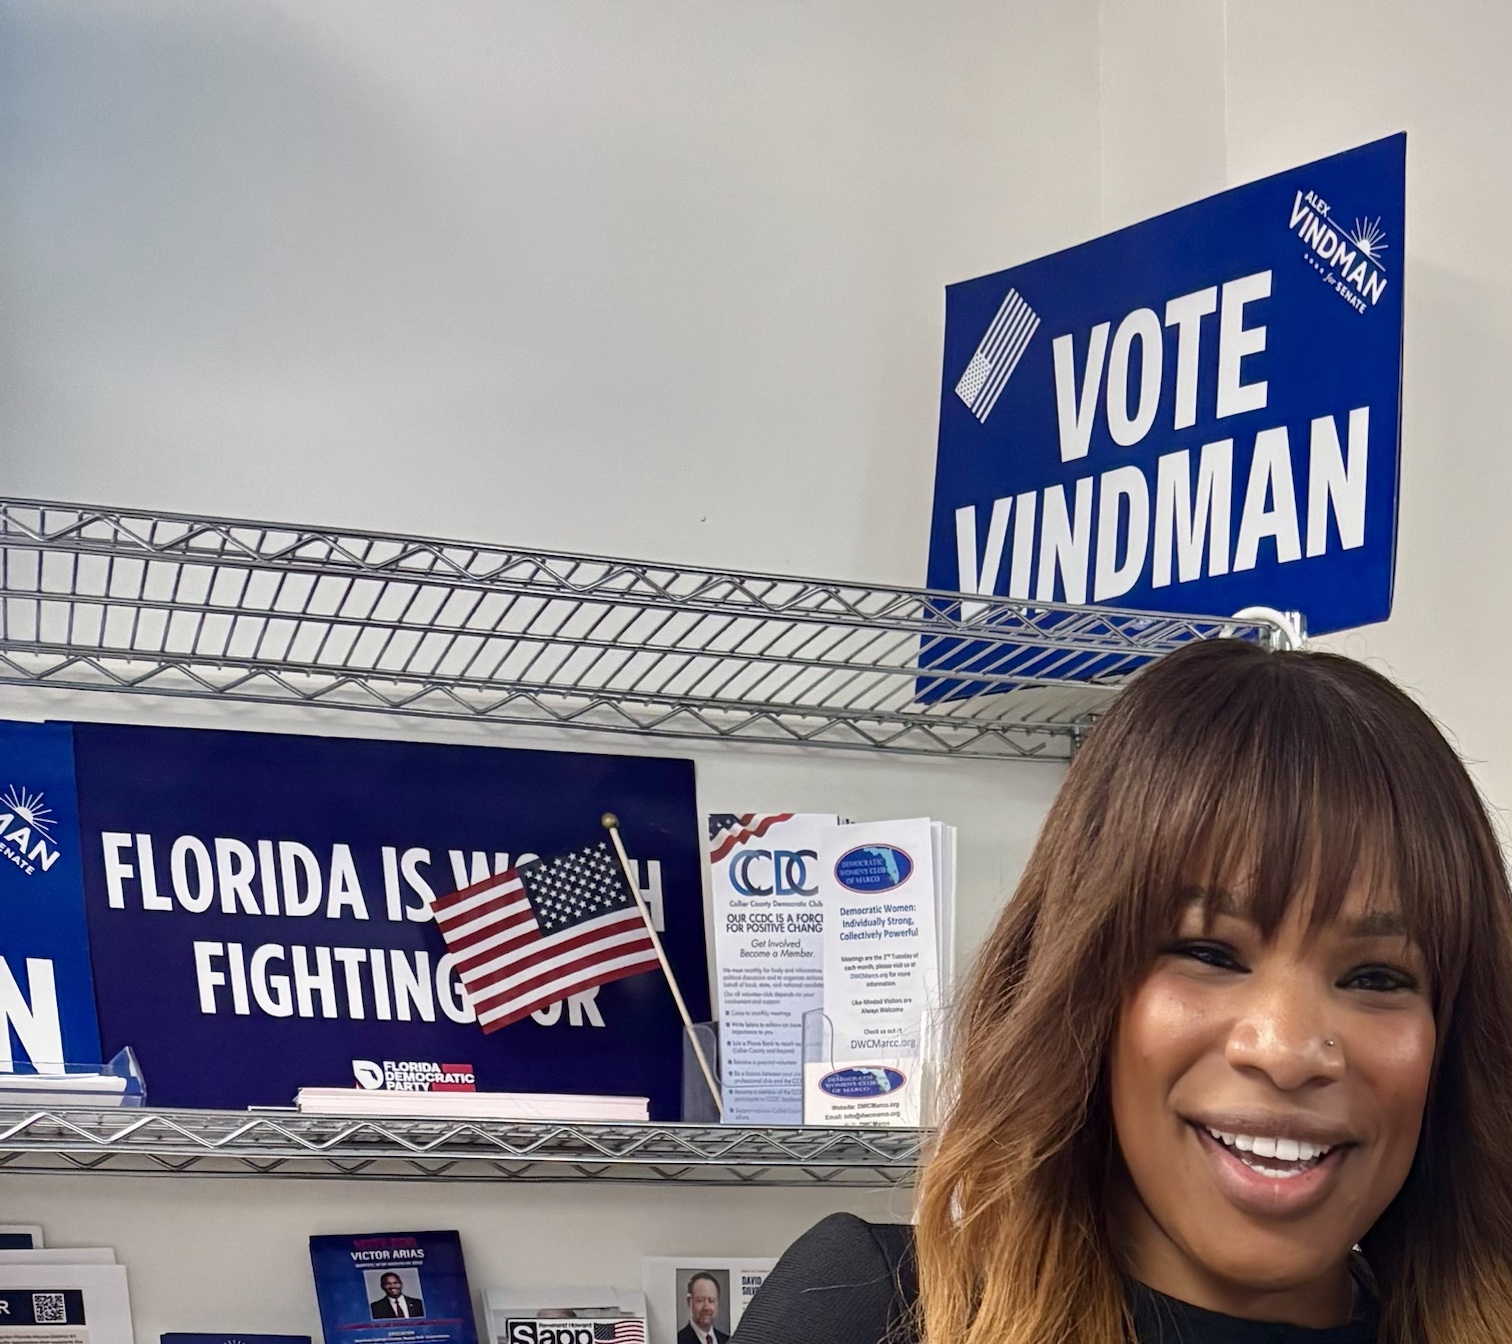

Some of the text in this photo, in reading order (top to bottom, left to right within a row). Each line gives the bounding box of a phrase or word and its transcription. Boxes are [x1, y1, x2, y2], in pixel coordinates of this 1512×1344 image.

[1305, 191, 1331, 218] ALEX
[1289, 190, 1387, 305] VINDMAN
[1323, 273, 1367, 314] for SENATE
[1053, 269, 1272, 462] VOTE
[955, 406, 1370, 622] VINDMAN
[101, 832, 370, 920] FLORIDA
[381, 847, 436, 923] IS
[729, 850, 818, 896] CCDC
[840, 905, 916, 916] Democratic Women:
[727, 914, 746, 923] OUR
[749, 914, 773, 923] CCDC
[776, 914, 784, 923] IS
[787, 914, 793, 923] A
[843, 917, 914, 928] Individually Strong,
[727, 924, 744, 933] FOR
[747, 924, 784, 933] POSITIVE
[840, 928, 918, 940] Collectively Powerful
[751, 939, 766, 948] Get
[740, 949, 770, 958] Become
[193, 941, 477, 1025] FIGHTING
[383, 1061, 441, 1073] FLORIDA
[385, 1072, 475, 1083] DEMOCRATIC
[387, 1082, 430, 1091] PARTY
[350, 1249, 425, 1261] VICTOR ARIAS
[742, 1277, 761, 1285] DAVID
